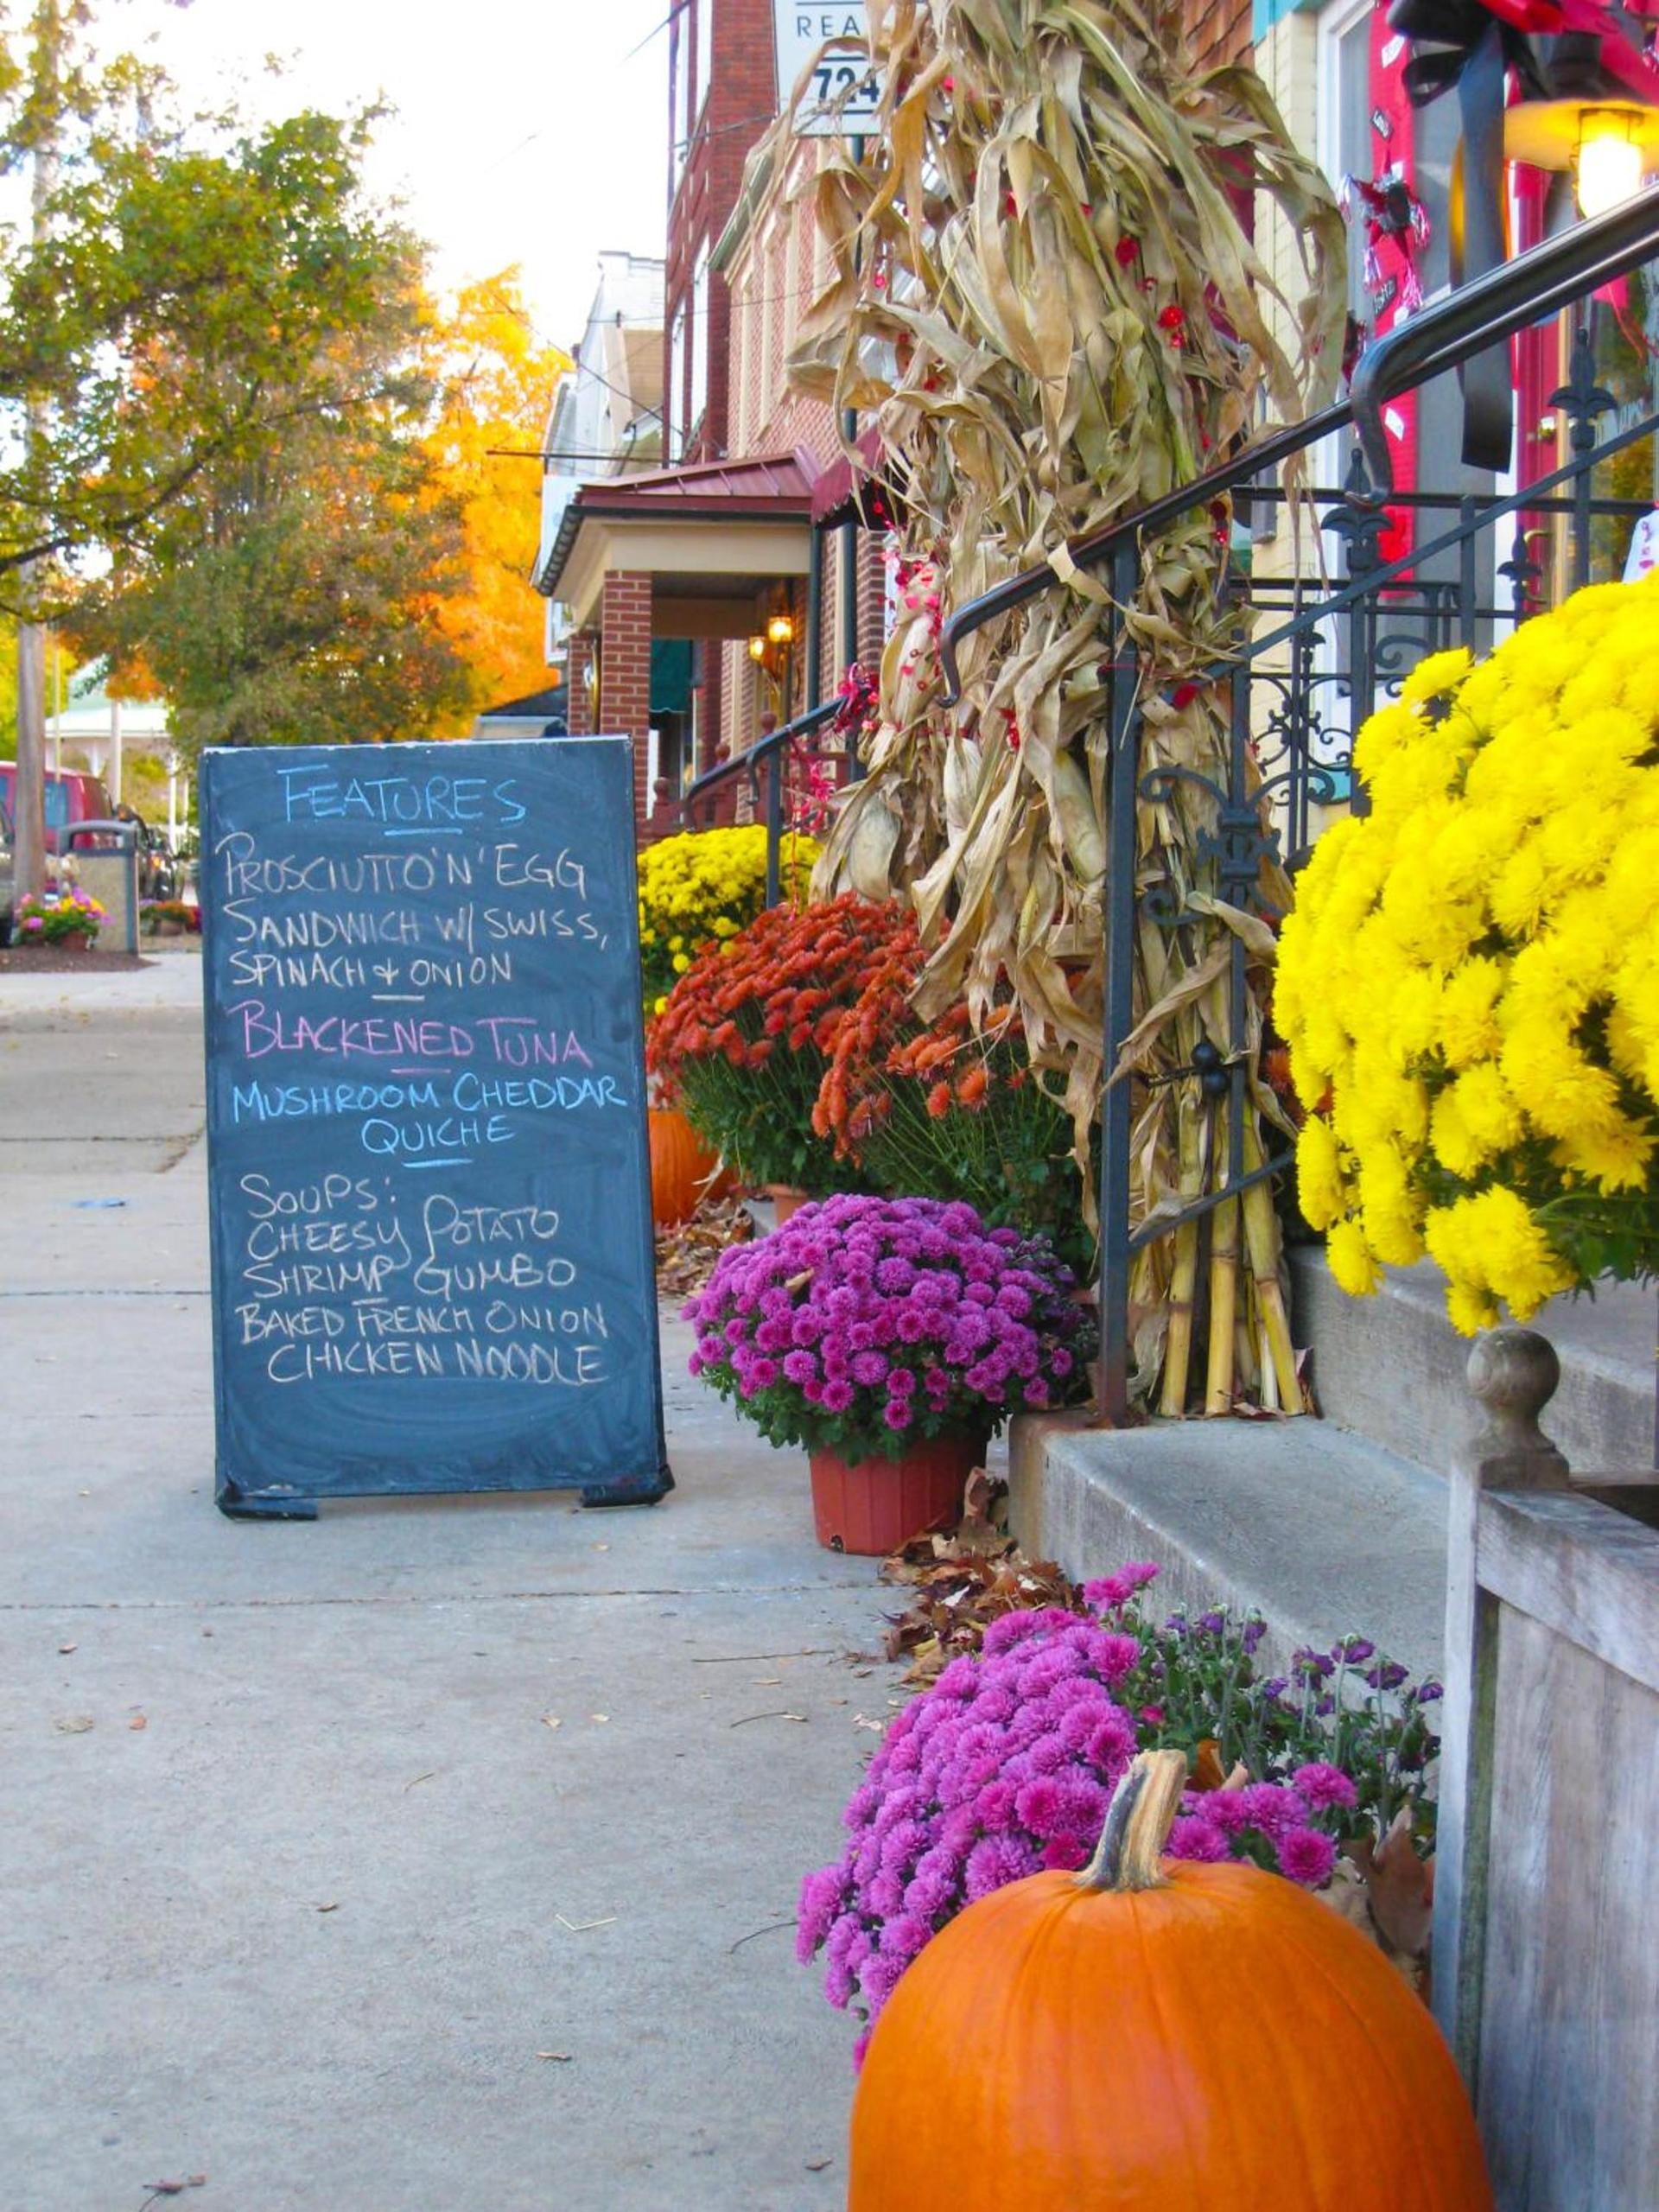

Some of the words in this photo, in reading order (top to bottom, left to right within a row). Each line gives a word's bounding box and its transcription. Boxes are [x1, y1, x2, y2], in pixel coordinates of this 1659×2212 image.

[797, 15, 861, 36] REA
[814, 67, 880, 104] 724
[276, 765, 526, 823] FEATURES
[495, 843, 587, 900] EGG
[223, 898, 419, 948] SANDWICH
[229, 950, 366, 988] SPINACH
[410, 953, 512, 986] ONION
[226, 1000, 474, 1059] BLACKENED
[476, 1017, 594, 1070] TUNA
[232, 1080, 439, 1123] MUSHROOM
[454, 1072, 628, 1112] CHEDDAR
[361, 1115, 517, 1155] QUICHE
[247, 1215, 412, 1270] CHEESY
[423, 1194, 560, 1262] POTATO
[243, 1254, 393, 1299] SHRIMP
[414, 1253, 576, 1302] GUMBO
[235, 1301, 344, 1344] BAKED
[352, 1297, 474, 1338] FRENCH
[486, 1299, 609, 1338] ONION
[268, 1342, 442, 1383] CHICKEN
[455, 1338, 610, 1385] NOODLE
